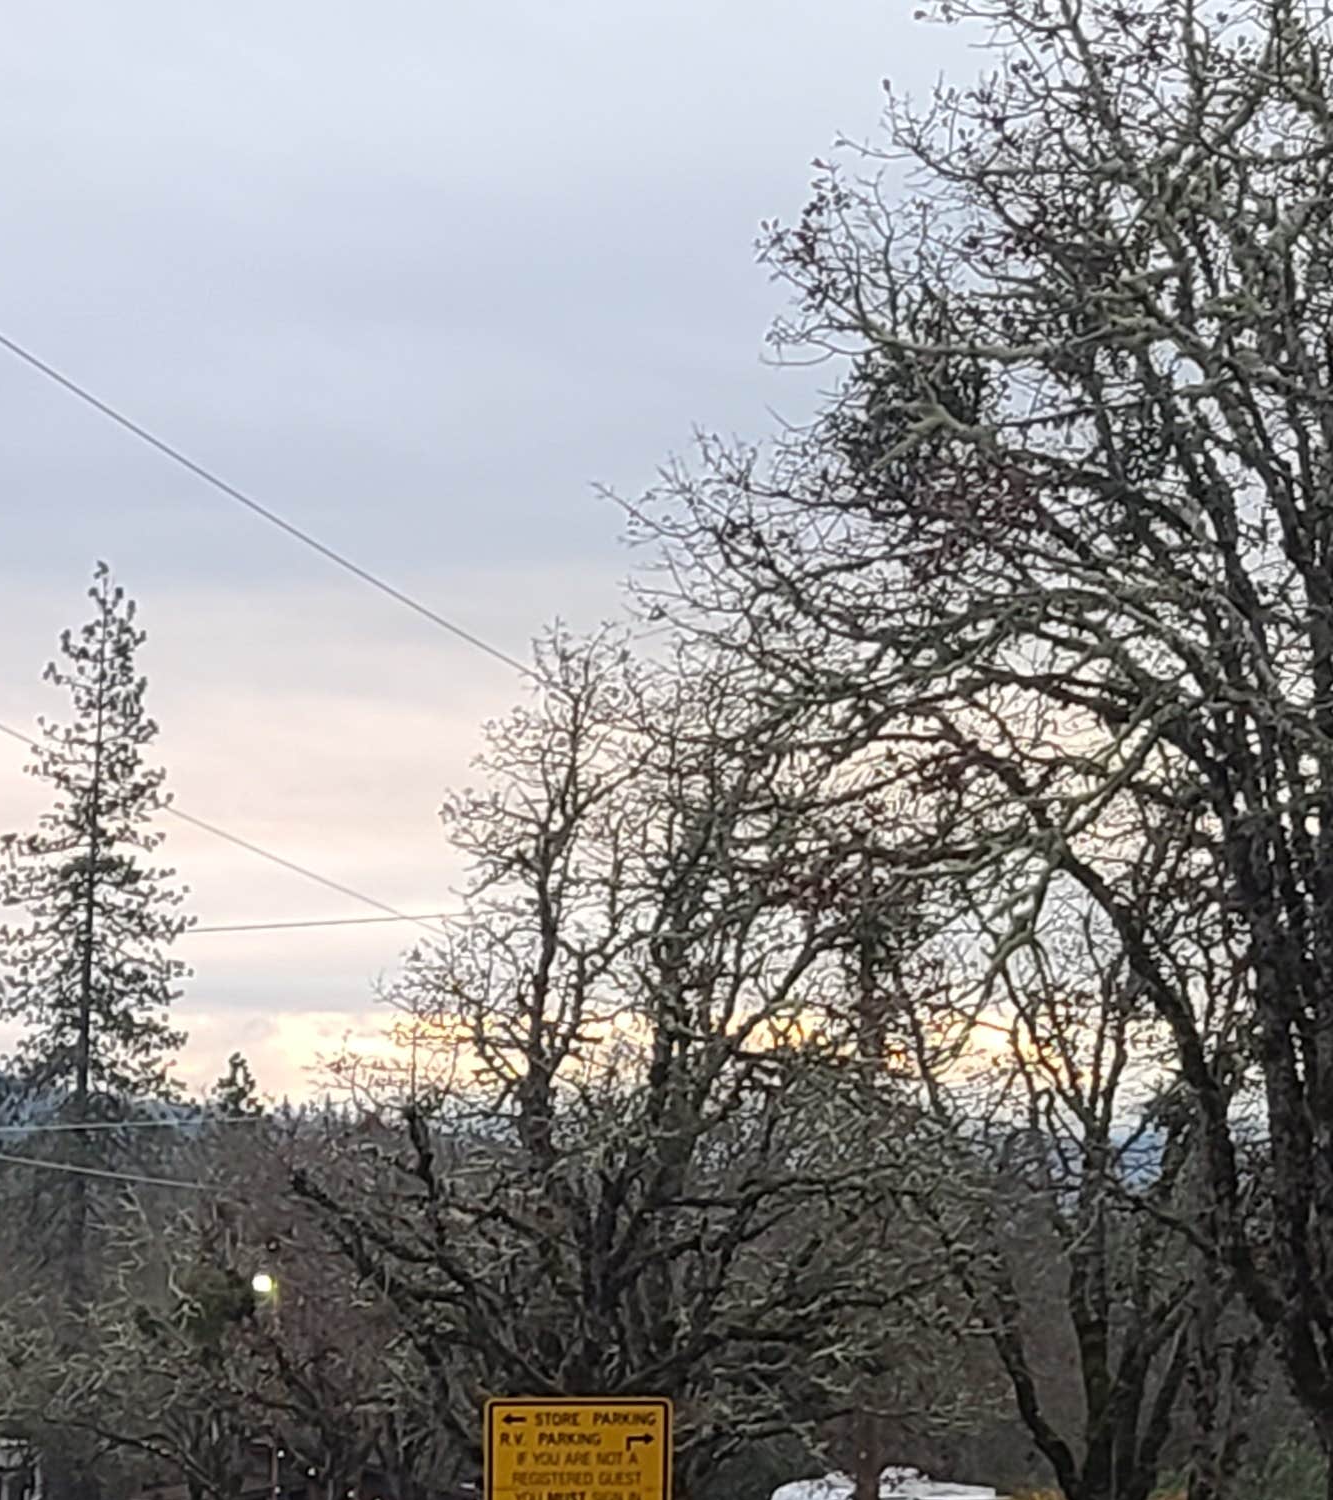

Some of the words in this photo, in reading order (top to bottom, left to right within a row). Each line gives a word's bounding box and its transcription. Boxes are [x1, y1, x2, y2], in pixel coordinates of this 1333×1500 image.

[535, 1412, 581, 1426] STORE
[593, 1412, 657, 1426] PARKING
[538, 1432, 602, 1446] PARKING
[517, 1452, 526, 1465] IF
[533, 1452, 559, 1465] YOU
[564, 1452, 589, 1465] ARE
[597, 1452, 623, 1465] NOT
[628, 1452, 638, 1465] A
[512, 1472, 593, 1485] REGISTERED
[599, 1472, 641, 1485] GUEST
